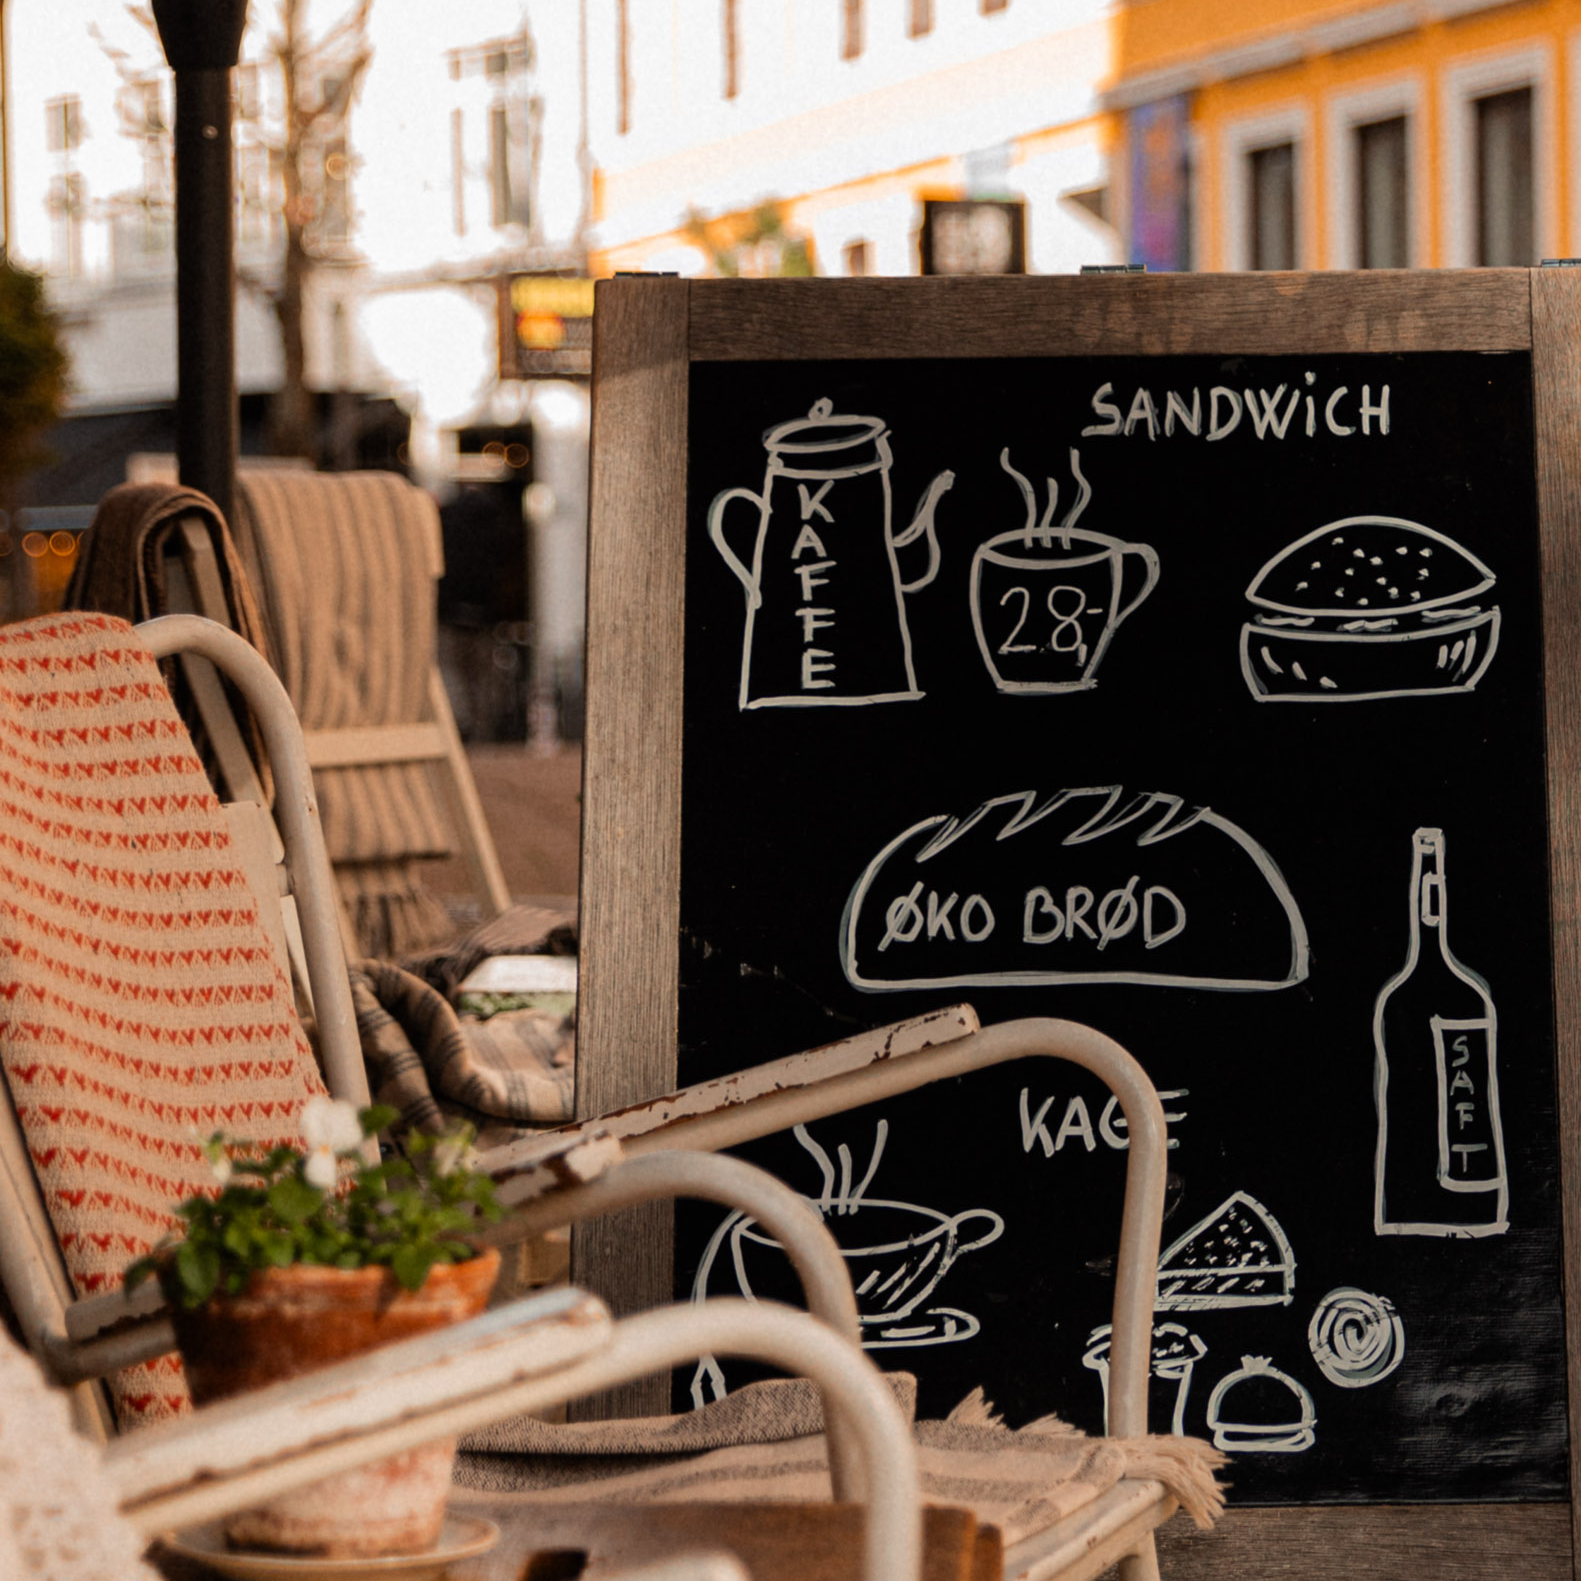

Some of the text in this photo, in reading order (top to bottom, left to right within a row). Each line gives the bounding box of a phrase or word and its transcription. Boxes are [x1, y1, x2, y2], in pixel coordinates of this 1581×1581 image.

[791, 479, 838, 690] KAFFE
[876, 875, 1187, 953] ØKO BRØD
[1449, 1034, 1489, 1174] SAFT
